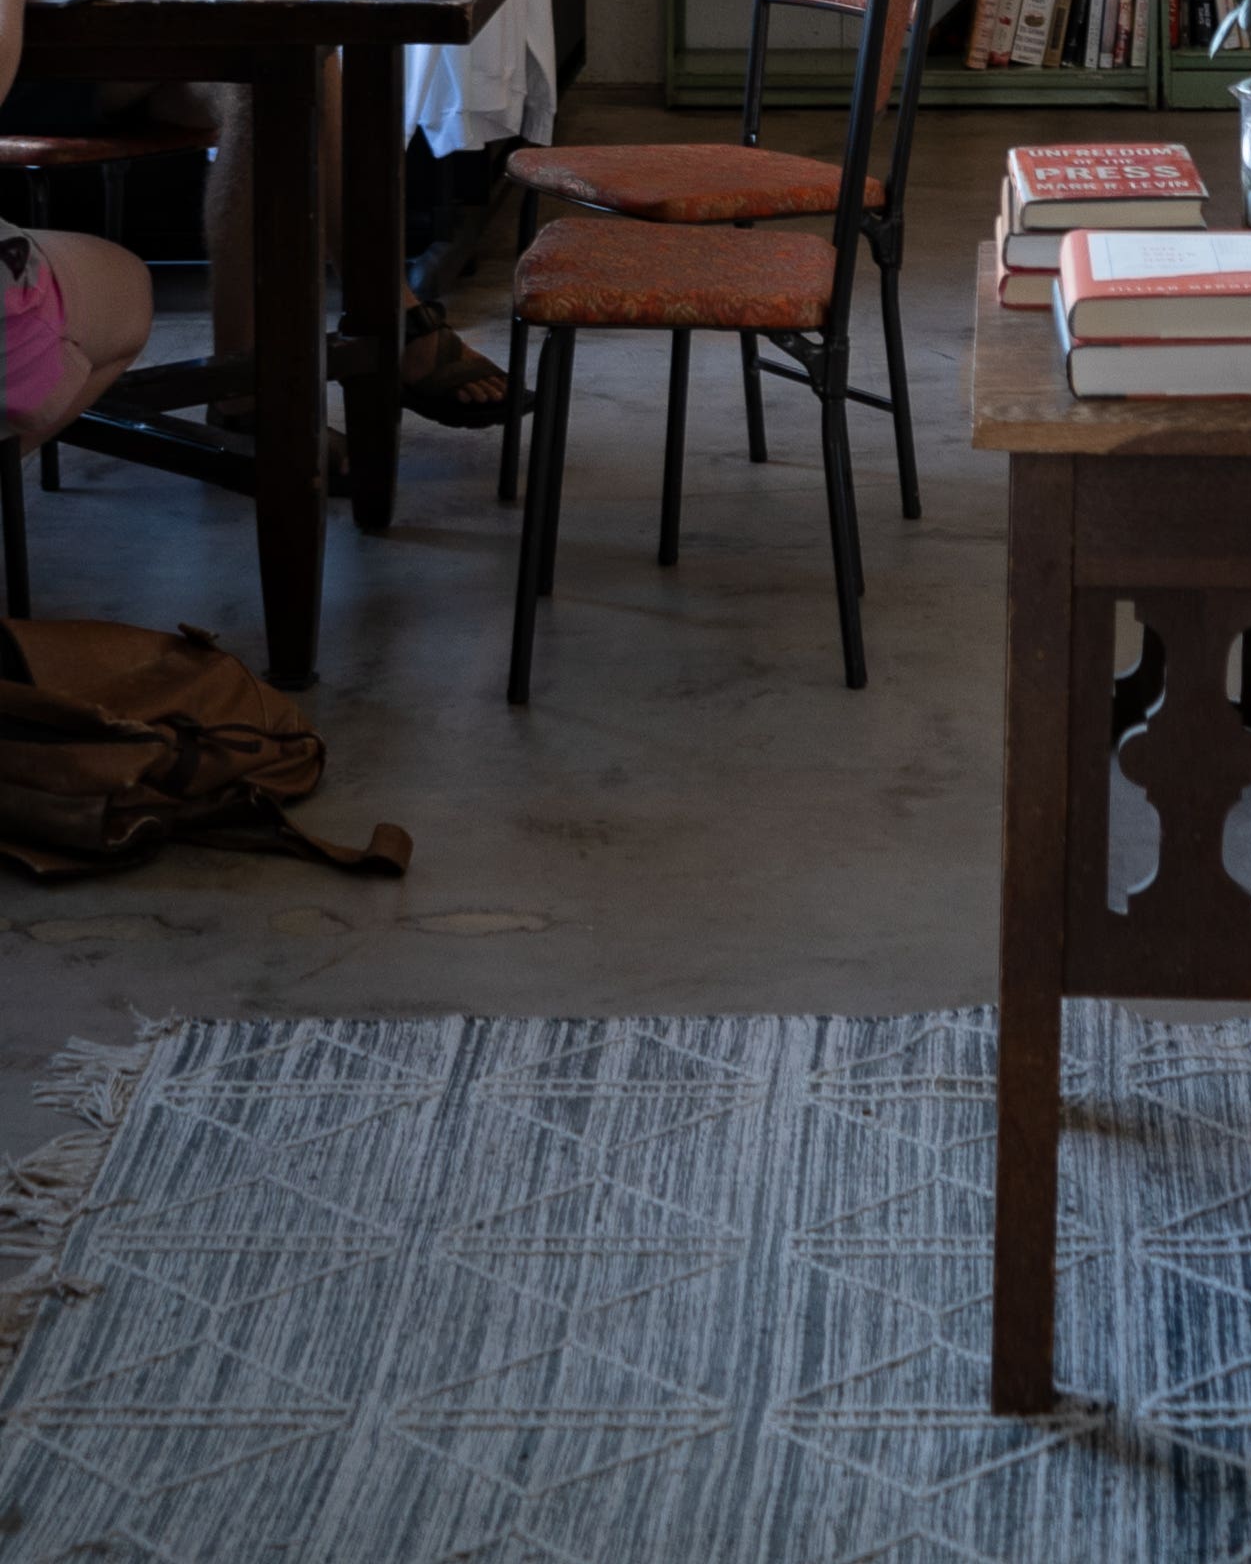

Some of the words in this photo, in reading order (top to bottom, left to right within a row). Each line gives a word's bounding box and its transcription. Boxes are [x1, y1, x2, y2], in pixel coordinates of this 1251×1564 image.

[1028, 147, 1173, 157] UNFREEDOM
[1035, 166, 1181, 180] PRESS
[1036, 182, 1096, 190] MARK
[1129, 180, 1190, 189] LEVIN
